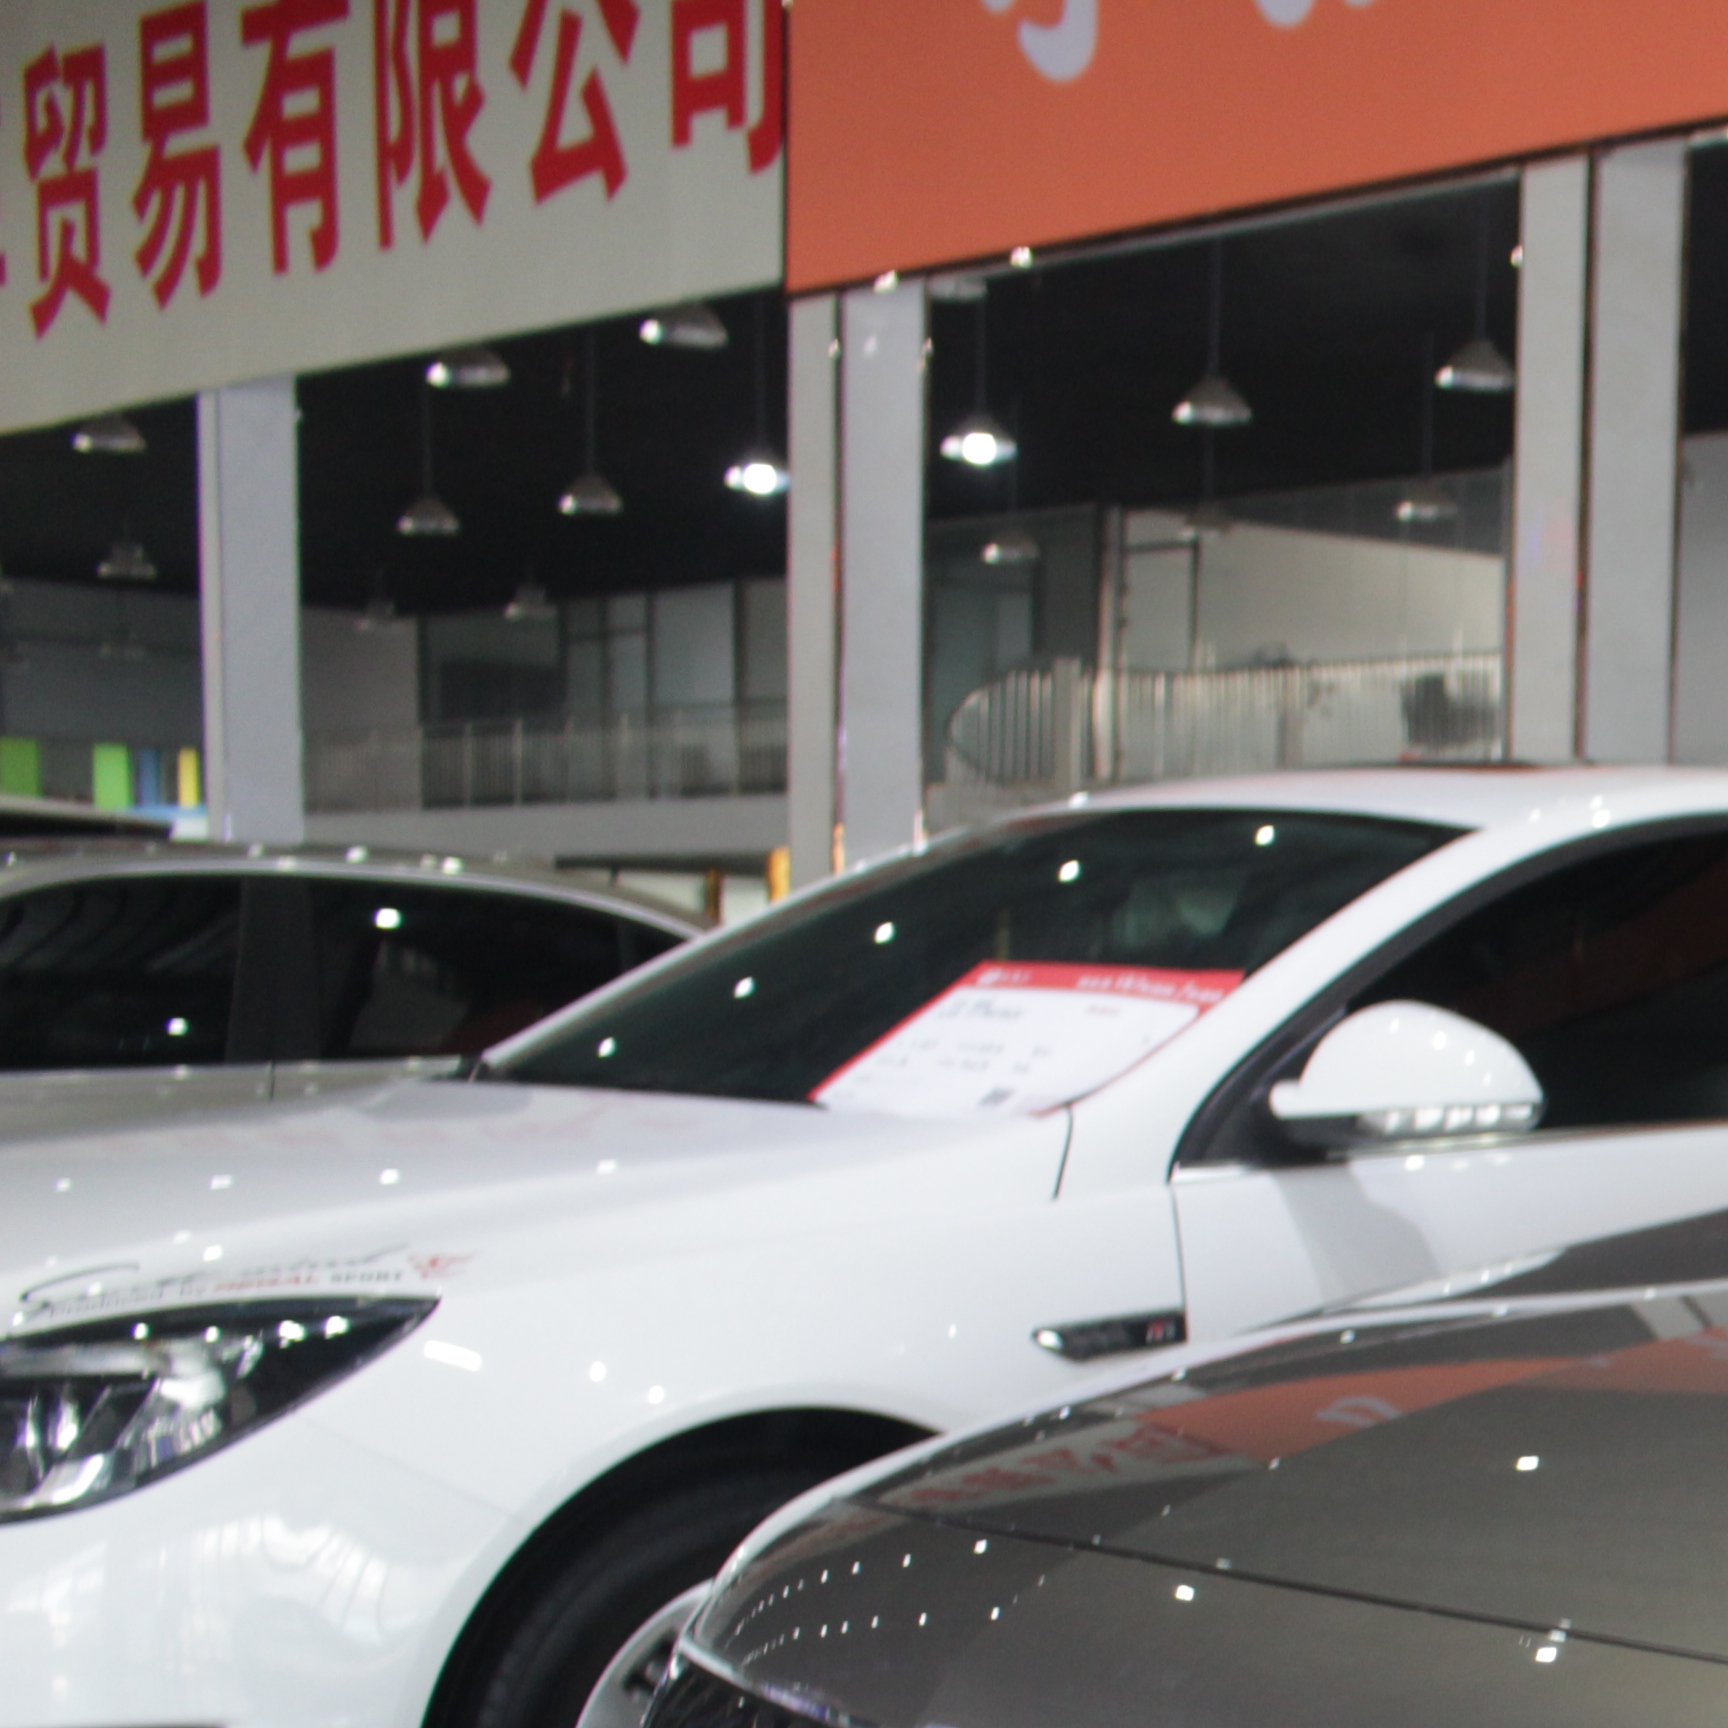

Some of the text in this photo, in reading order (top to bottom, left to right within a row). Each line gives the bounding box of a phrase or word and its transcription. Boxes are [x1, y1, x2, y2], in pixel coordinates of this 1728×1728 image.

[0, 0, 782, 339] 贸易有限公司
